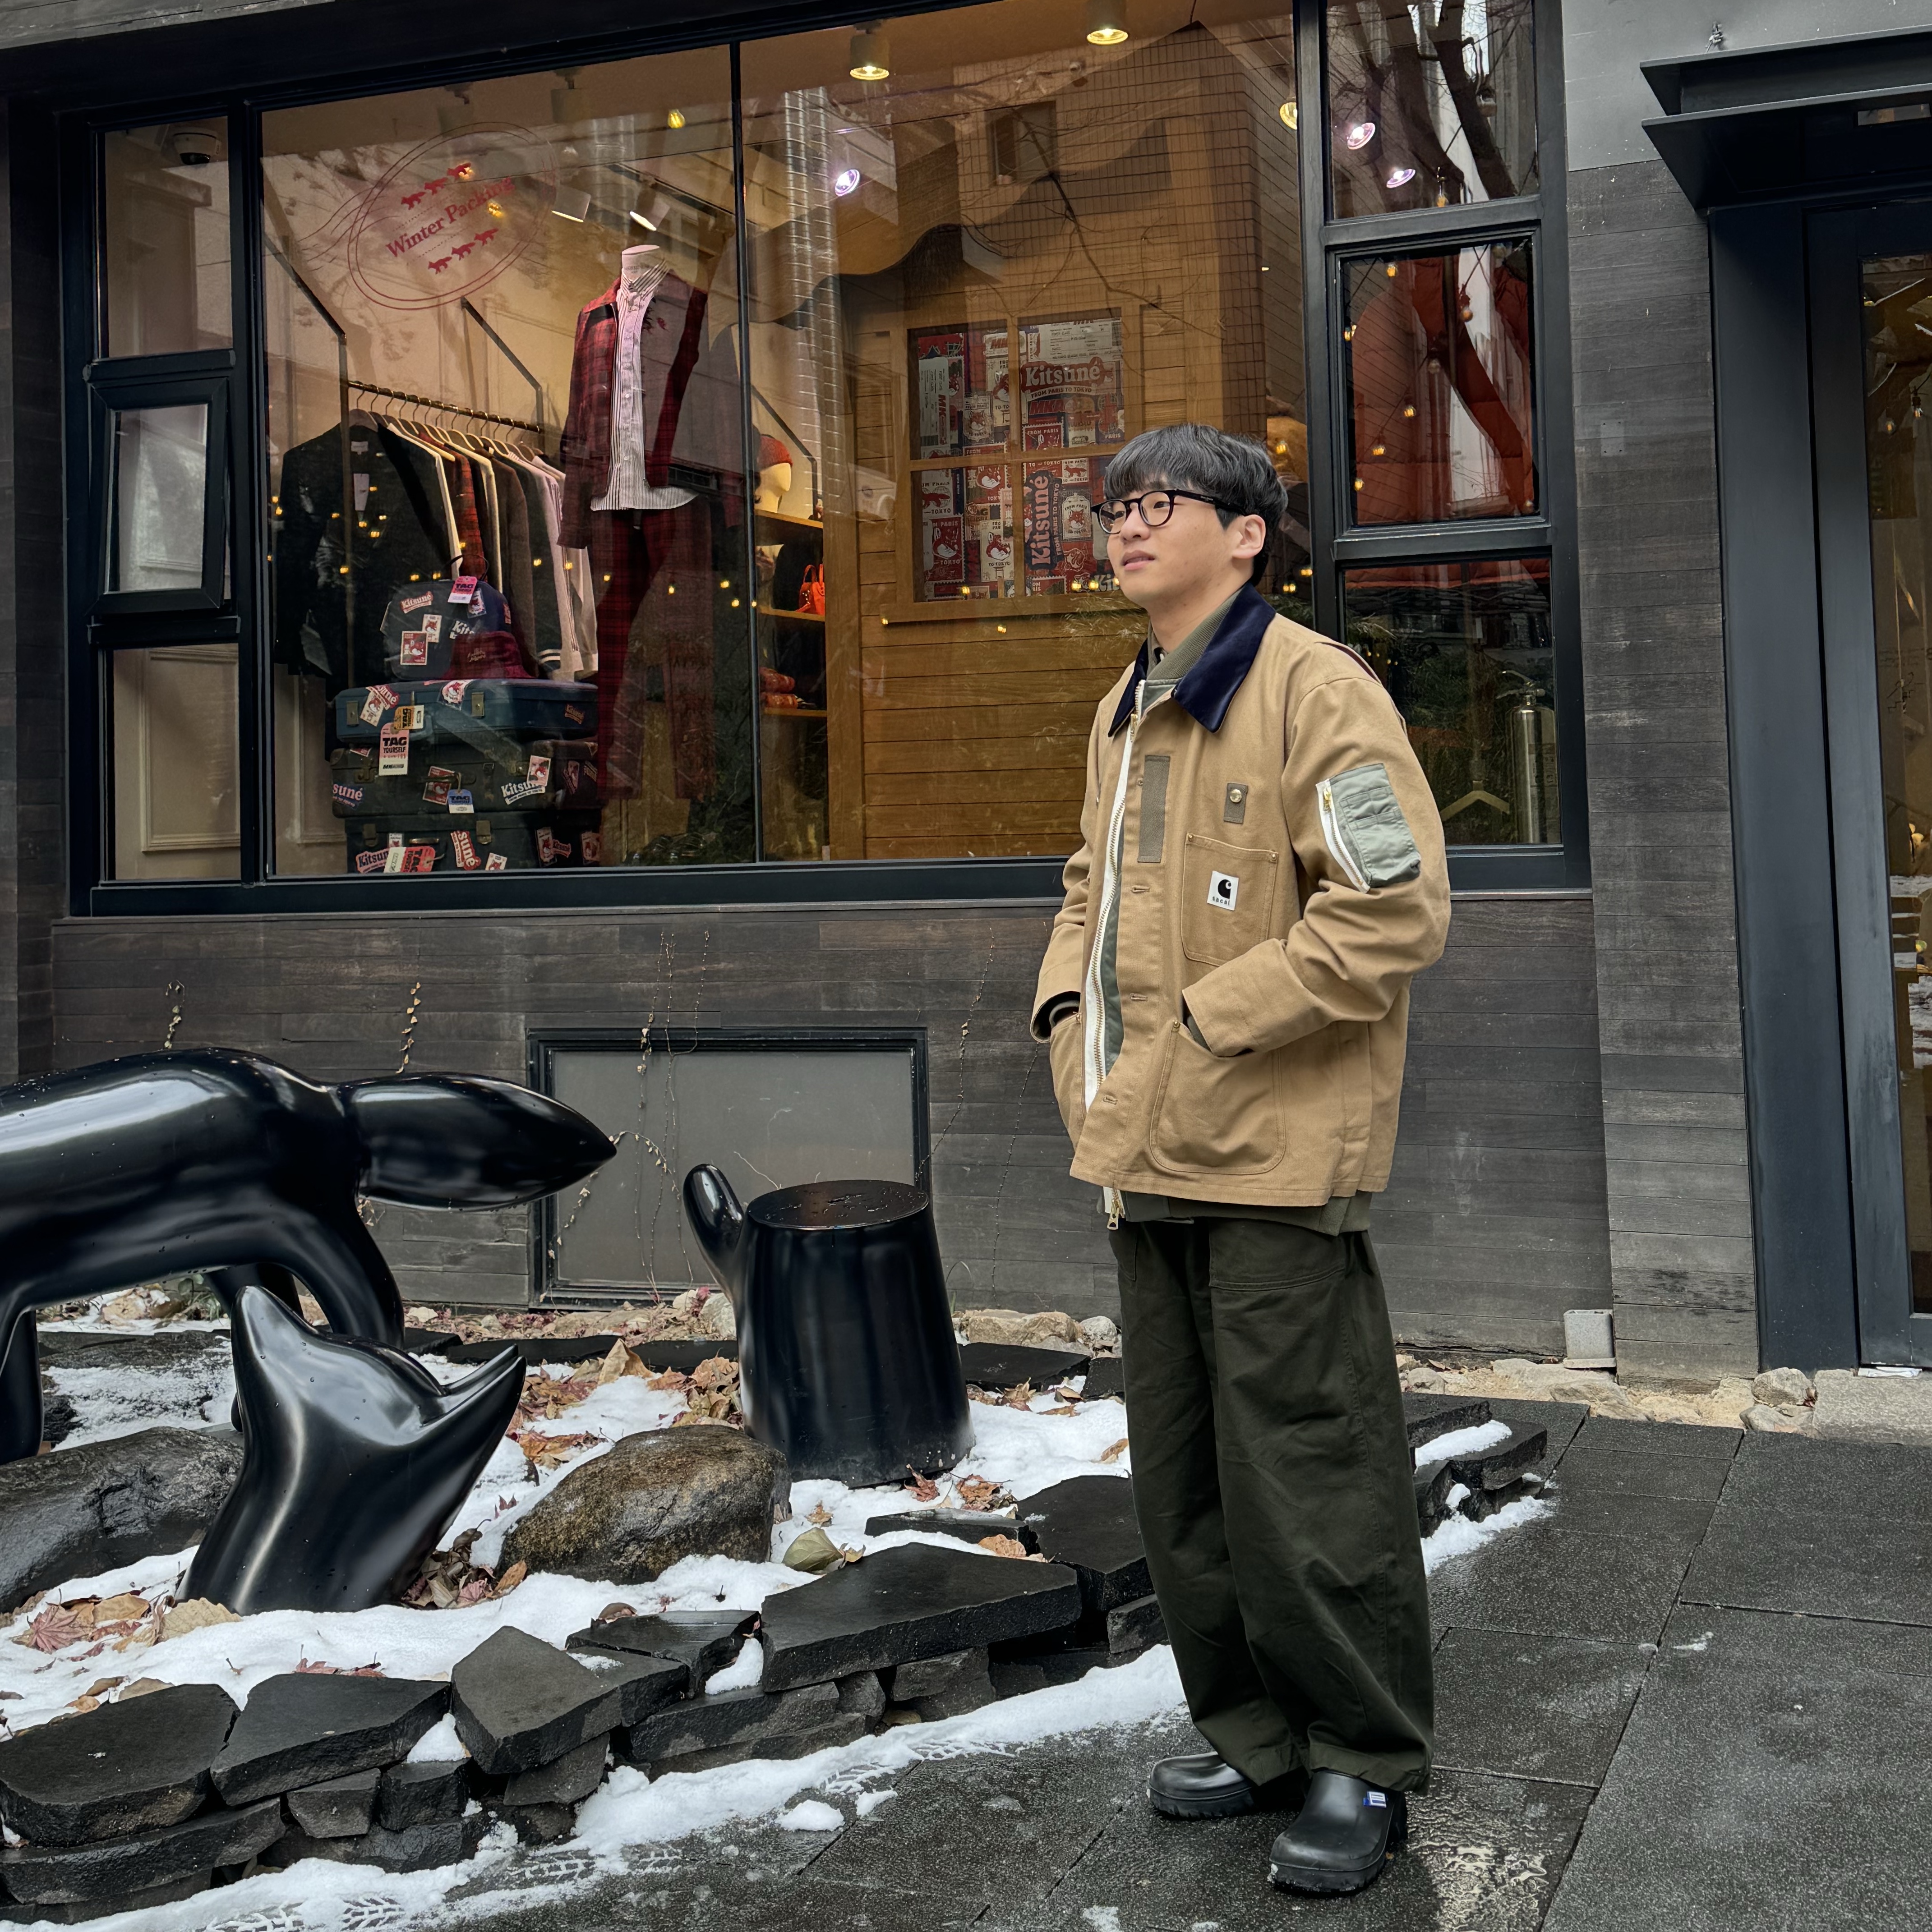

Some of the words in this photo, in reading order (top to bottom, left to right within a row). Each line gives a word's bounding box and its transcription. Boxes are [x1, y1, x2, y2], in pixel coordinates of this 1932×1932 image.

[386, 217, 444, 258] Winter
[444, 176, 516, 224] Packing
[1026, 361, 1100, 386] Kitsuné
[1031, 391, 1047, 399] FROM
[1029, 476, 1051, 565] Kitsuné
[383, 737, 407, 746] TAG
[332, 784, 363, 800] suné
[359, 851, 389, 867] Kitsun
[458, 832, 479, 867] suné
